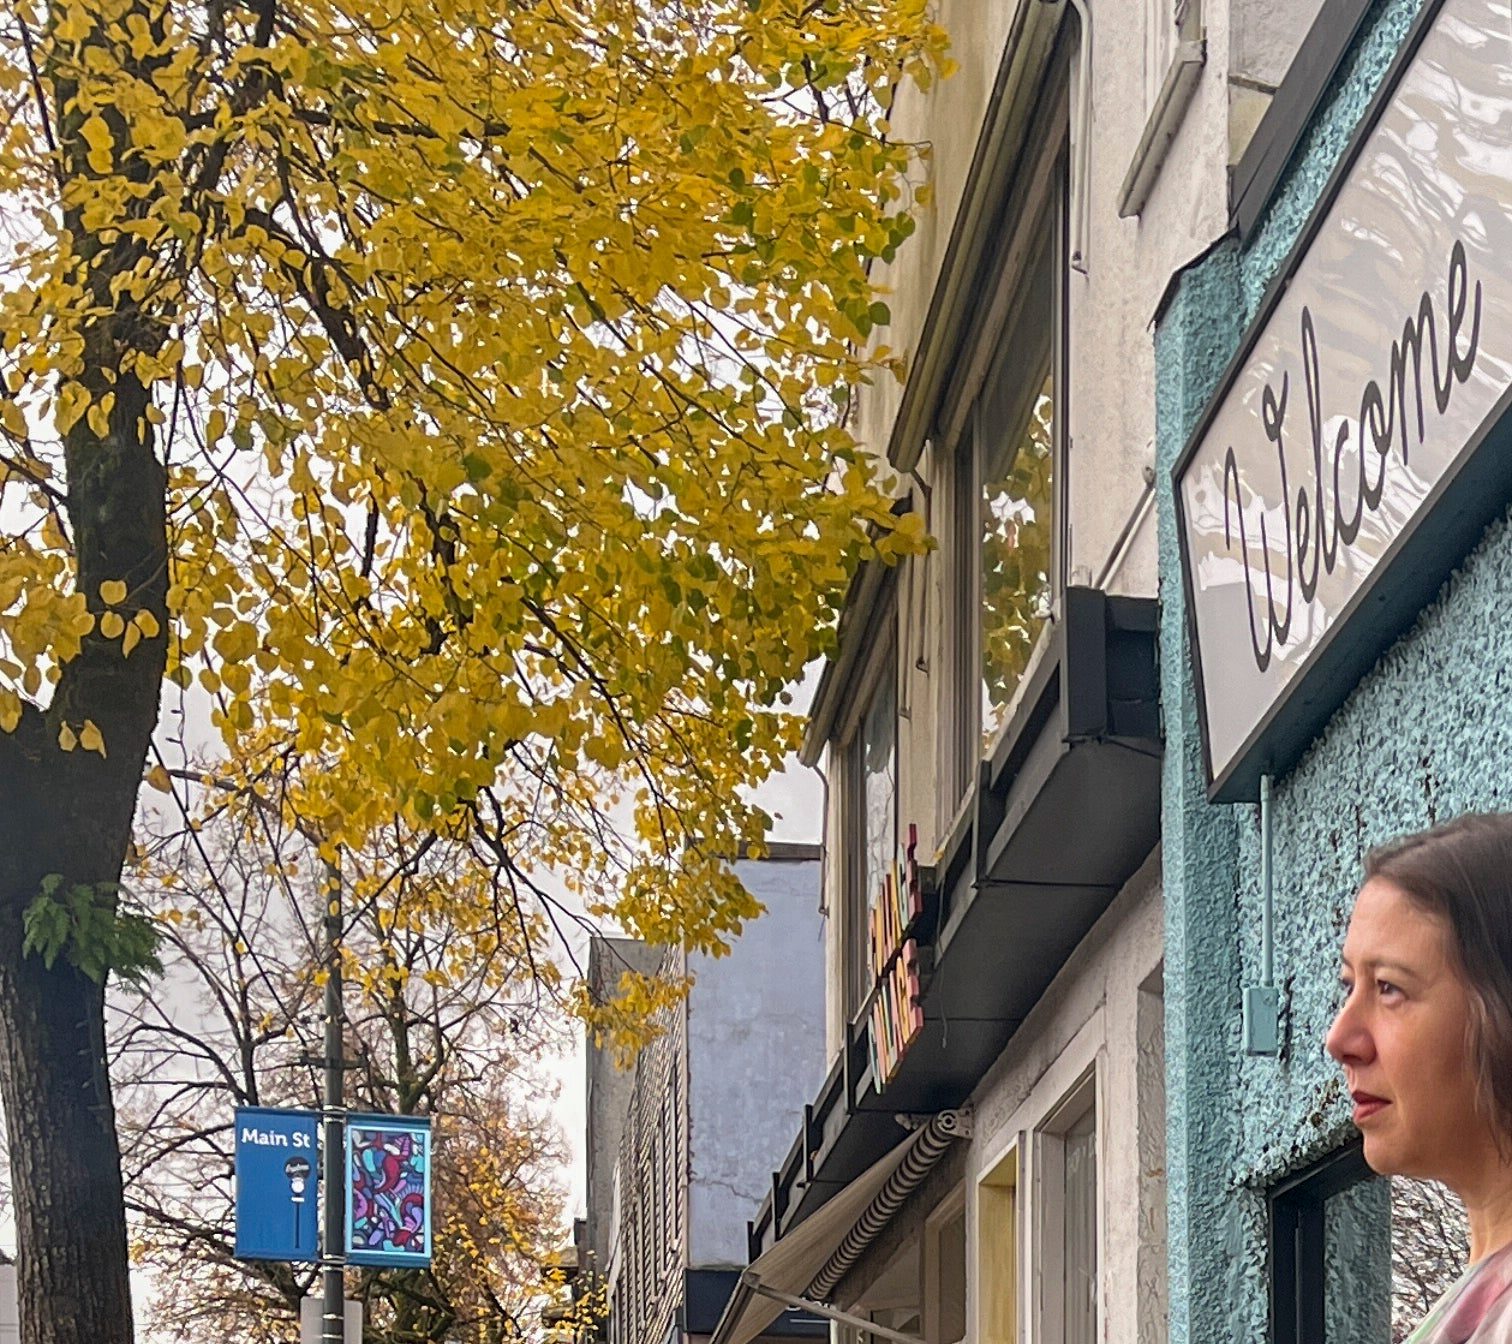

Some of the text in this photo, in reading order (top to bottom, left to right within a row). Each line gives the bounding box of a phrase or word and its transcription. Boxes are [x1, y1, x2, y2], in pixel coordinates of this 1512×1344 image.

[1224, 238, 1483, 674] Welcome
[241, 1127, 311, 1148] Main St
